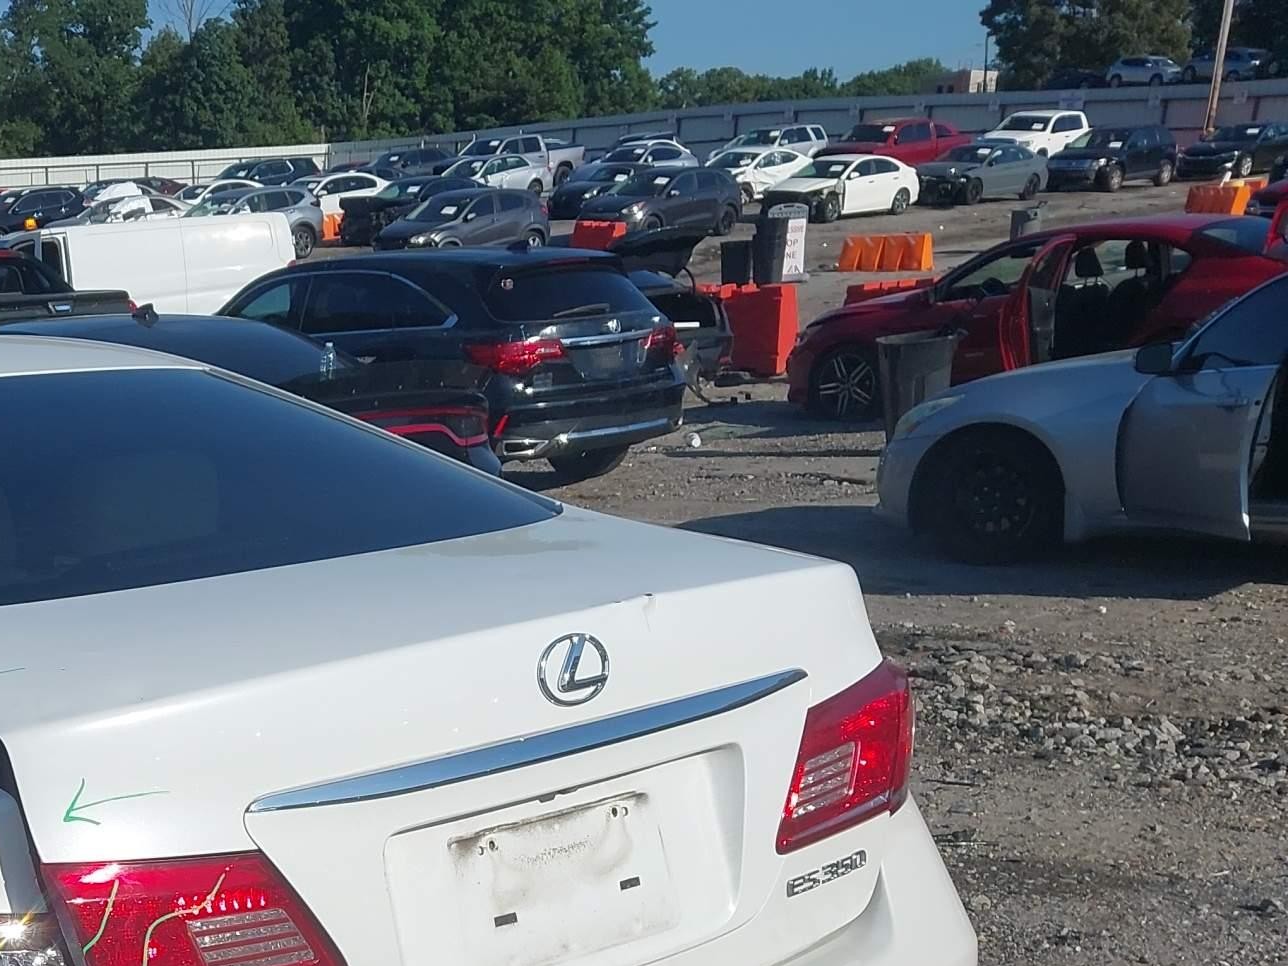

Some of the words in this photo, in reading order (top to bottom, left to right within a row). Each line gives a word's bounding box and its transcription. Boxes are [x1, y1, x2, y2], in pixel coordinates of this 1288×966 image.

[786, 239, 799, 247] OP
[786, 869, 821, 898] ES
[821, 849, 867, 885] 350
